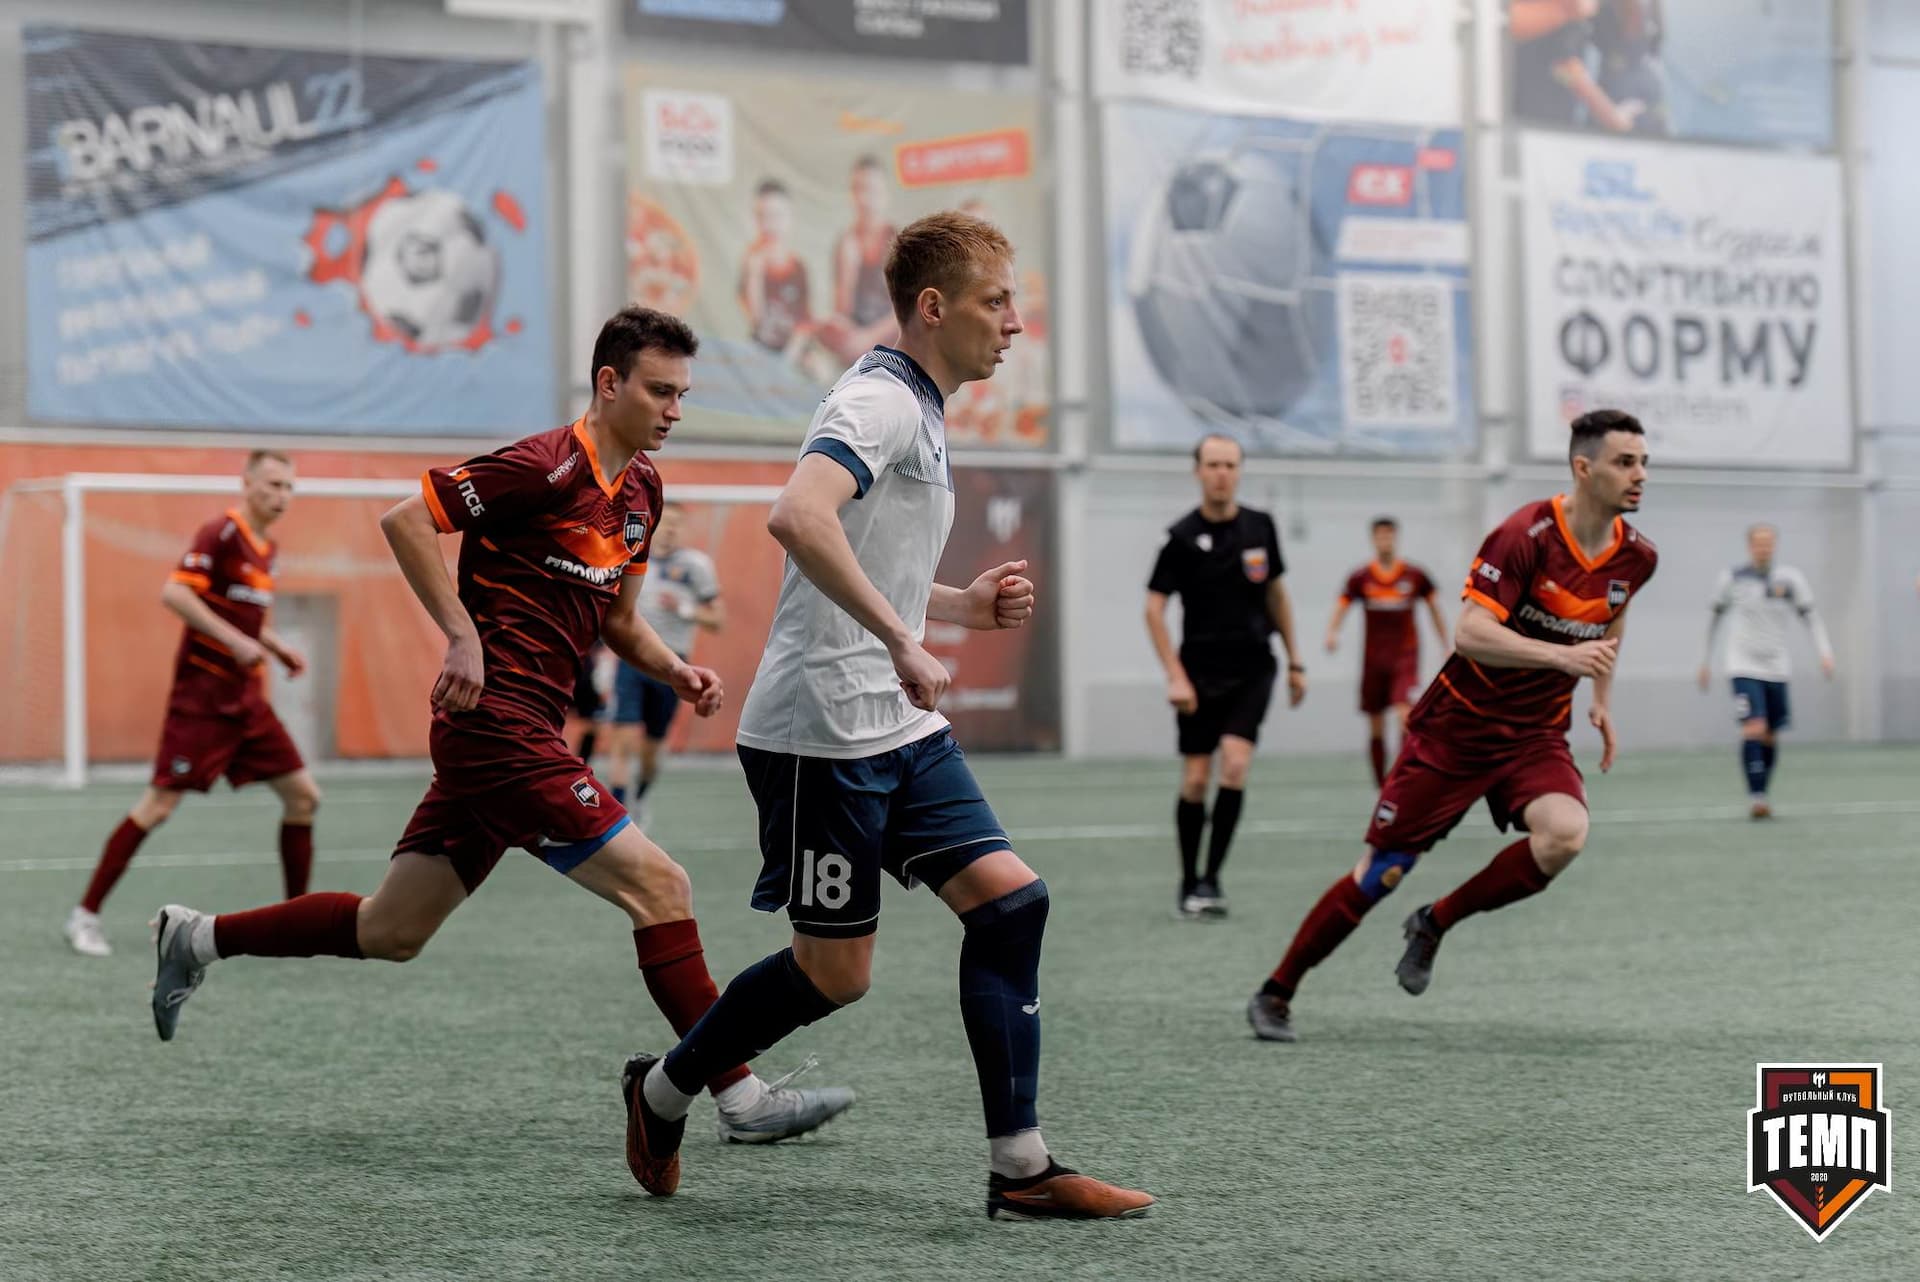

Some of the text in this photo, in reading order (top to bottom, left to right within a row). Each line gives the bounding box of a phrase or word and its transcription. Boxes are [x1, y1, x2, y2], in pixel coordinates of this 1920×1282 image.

[1554, 256, 1821, 309] СПОРТИВНУЮ
[1558, 306, 1818, 386] ФОРМУ
[458, 480, 486, 517] ПСБ
[801, 849, 852, 910] 18
